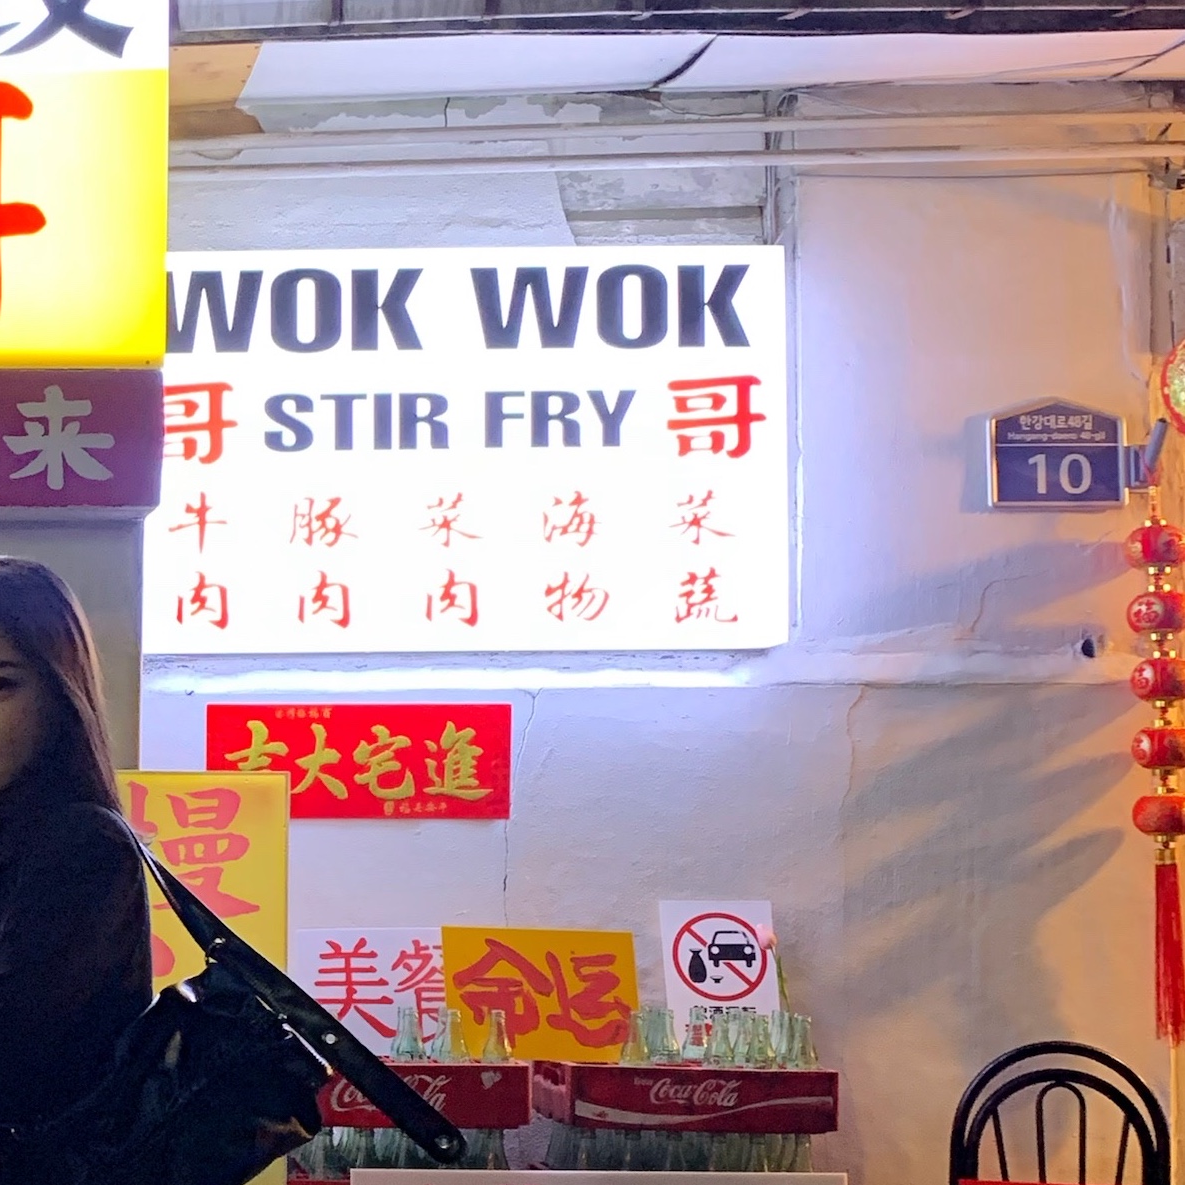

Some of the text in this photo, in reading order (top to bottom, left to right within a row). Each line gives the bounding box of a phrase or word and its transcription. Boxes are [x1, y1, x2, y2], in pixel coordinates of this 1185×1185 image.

[165, 264, 751, 353] WOK WOK
[165, 375, 767, 464] 哥 STIR FRY 哥
[1027, 453, 1092, 495] 10
[649, 1077, 742, 1107] Coca-Cola
